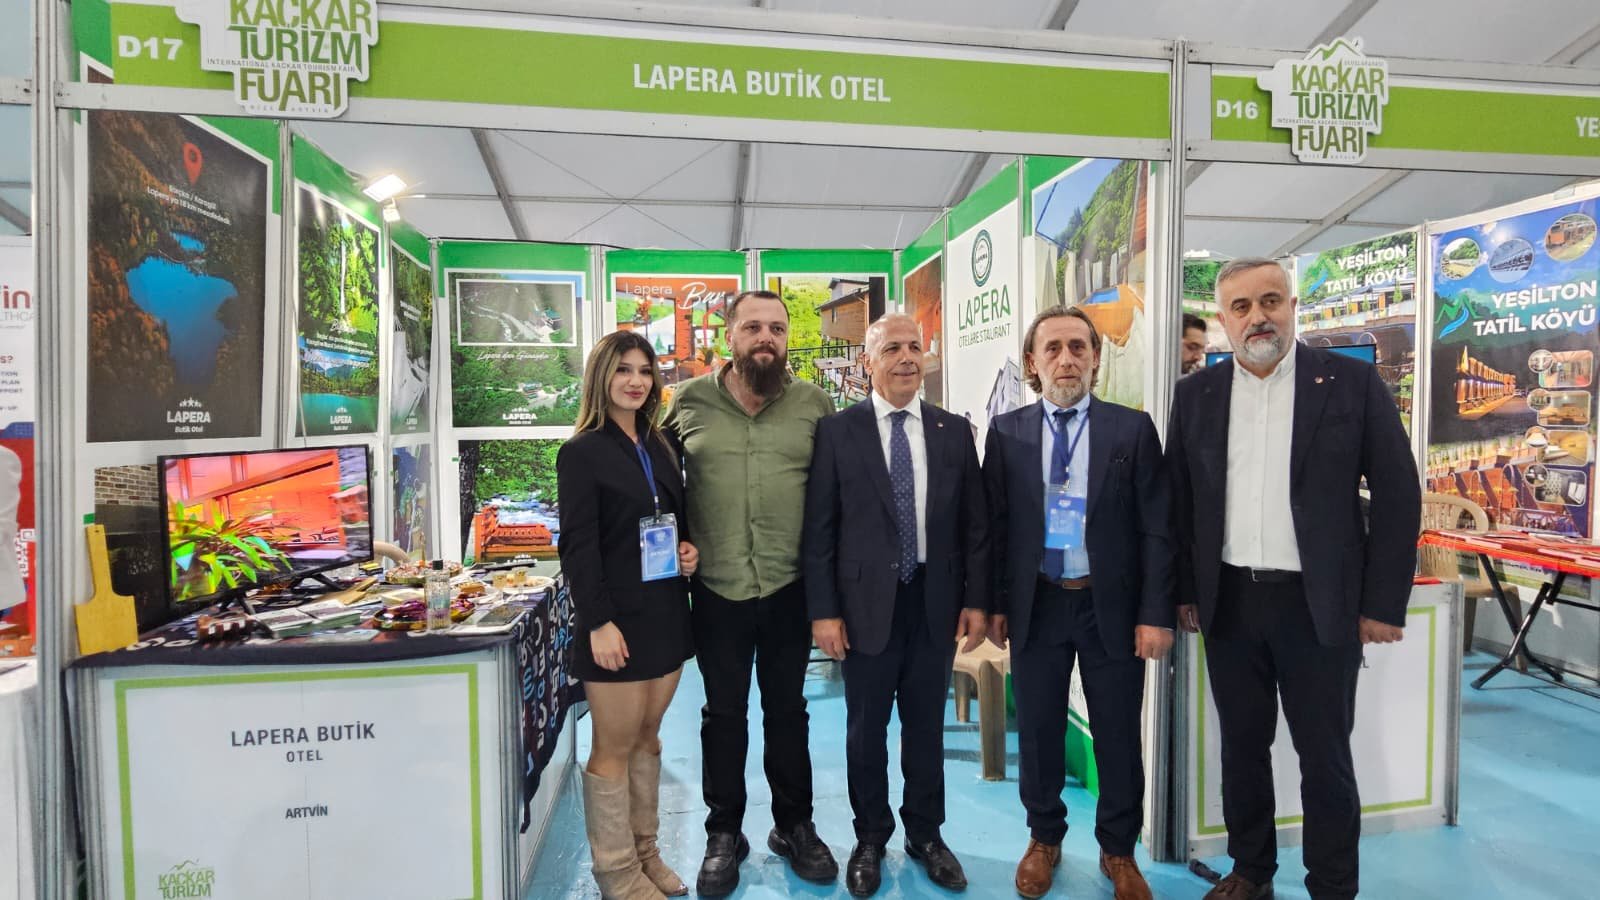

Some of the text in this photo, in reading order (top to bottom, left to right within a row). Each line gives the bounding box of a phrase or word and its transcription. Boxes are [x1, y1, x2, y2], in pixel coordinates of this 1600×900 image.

[118, 35, 184, 60] D17
[227, 25, 362, 74] TURİZM
[207, 58, 268, 68] INTERNATIONAL
[240, 68, 341, 111] FUARI
[633, 63, 891, 102] LAPERA BUTİK OTEL
[1216, 100, 1259, 119] D16
[1290, 90, 1378, 126] TURİZM
[1575, 116, 1600, 137] YE
[1298, 125, 1364, 158] FUARI
[1336, 244, 1408, 271] YEŞİLTON
[1325, 265, 1408, 294] TATİL KÖYÜ
[625, 282, 726, 309] Lapera Bar
[958, 284, 1011, 330] LAPERA
[1491, 280, 1597, 310] YEŞİLTON
[1473, 304, 1596, 337] TATİL KÖYÜ
[166, 411, 211, 423] LAPERA
[330, 415, 352, 425] LAPERA
[502, 412, 537, 420] LAPERA
[231, 721, 375, 747] LAPERA BUTİK
[286, 749, 323, 762] OTEL
[285, 803, 328, 819] ARTVİN
